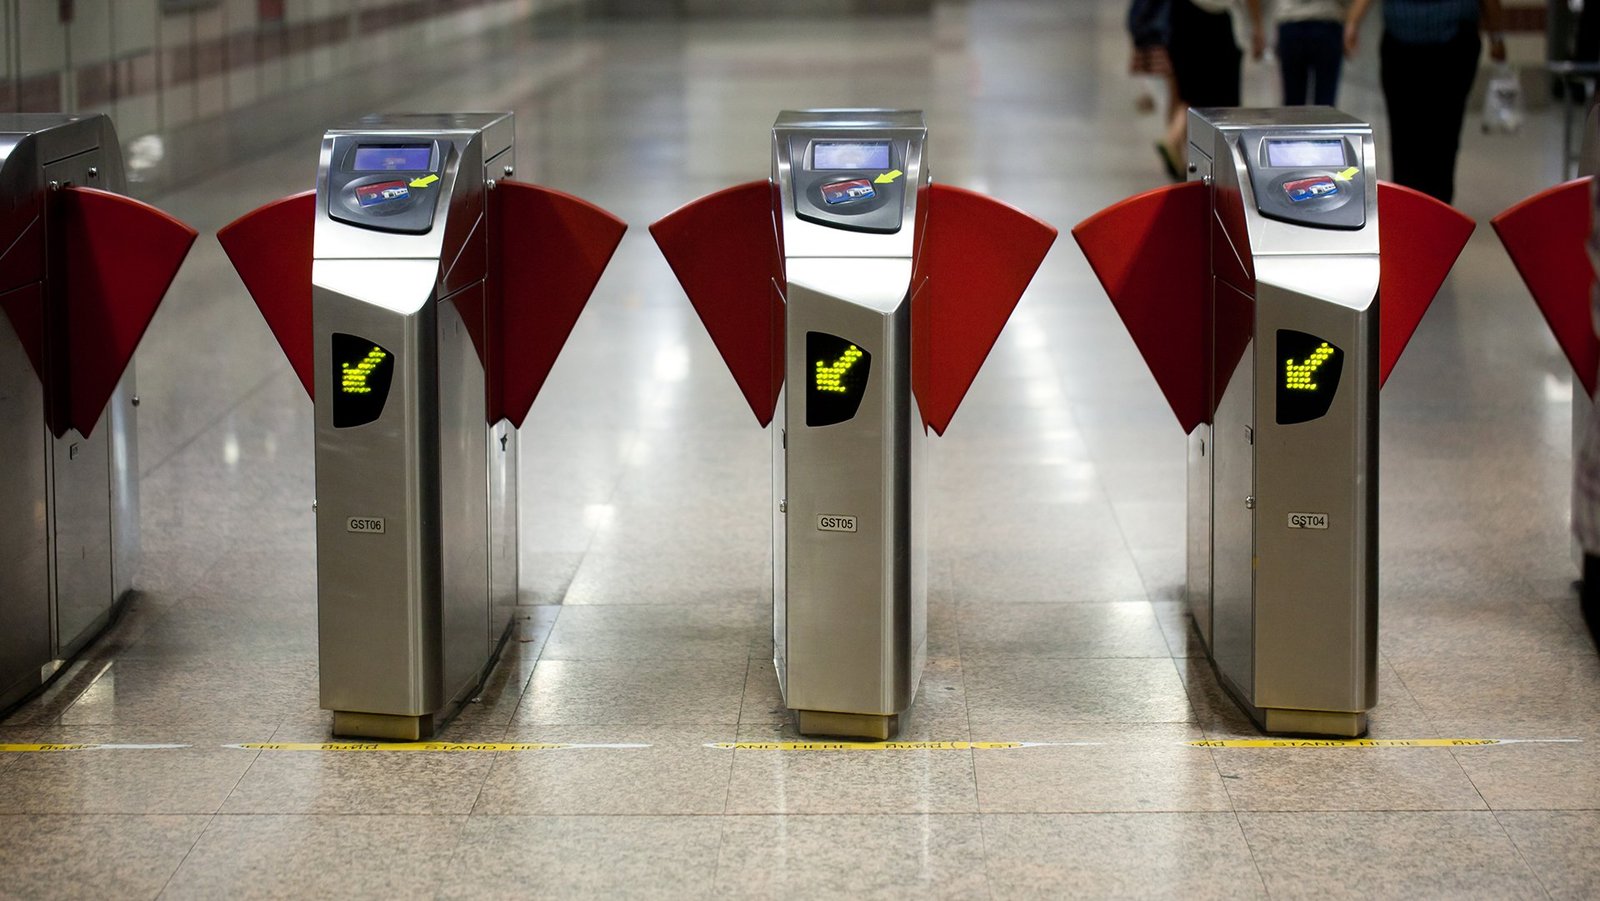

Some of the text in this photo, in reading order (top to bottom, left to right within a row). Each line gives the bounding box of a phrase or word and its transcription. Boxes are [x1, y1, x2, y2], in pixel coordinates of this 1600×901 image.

[350, 519, 382, 530] GST06
[820, 517, 853, 529] GST05
[1291, 515, 1324, 526] GST04
